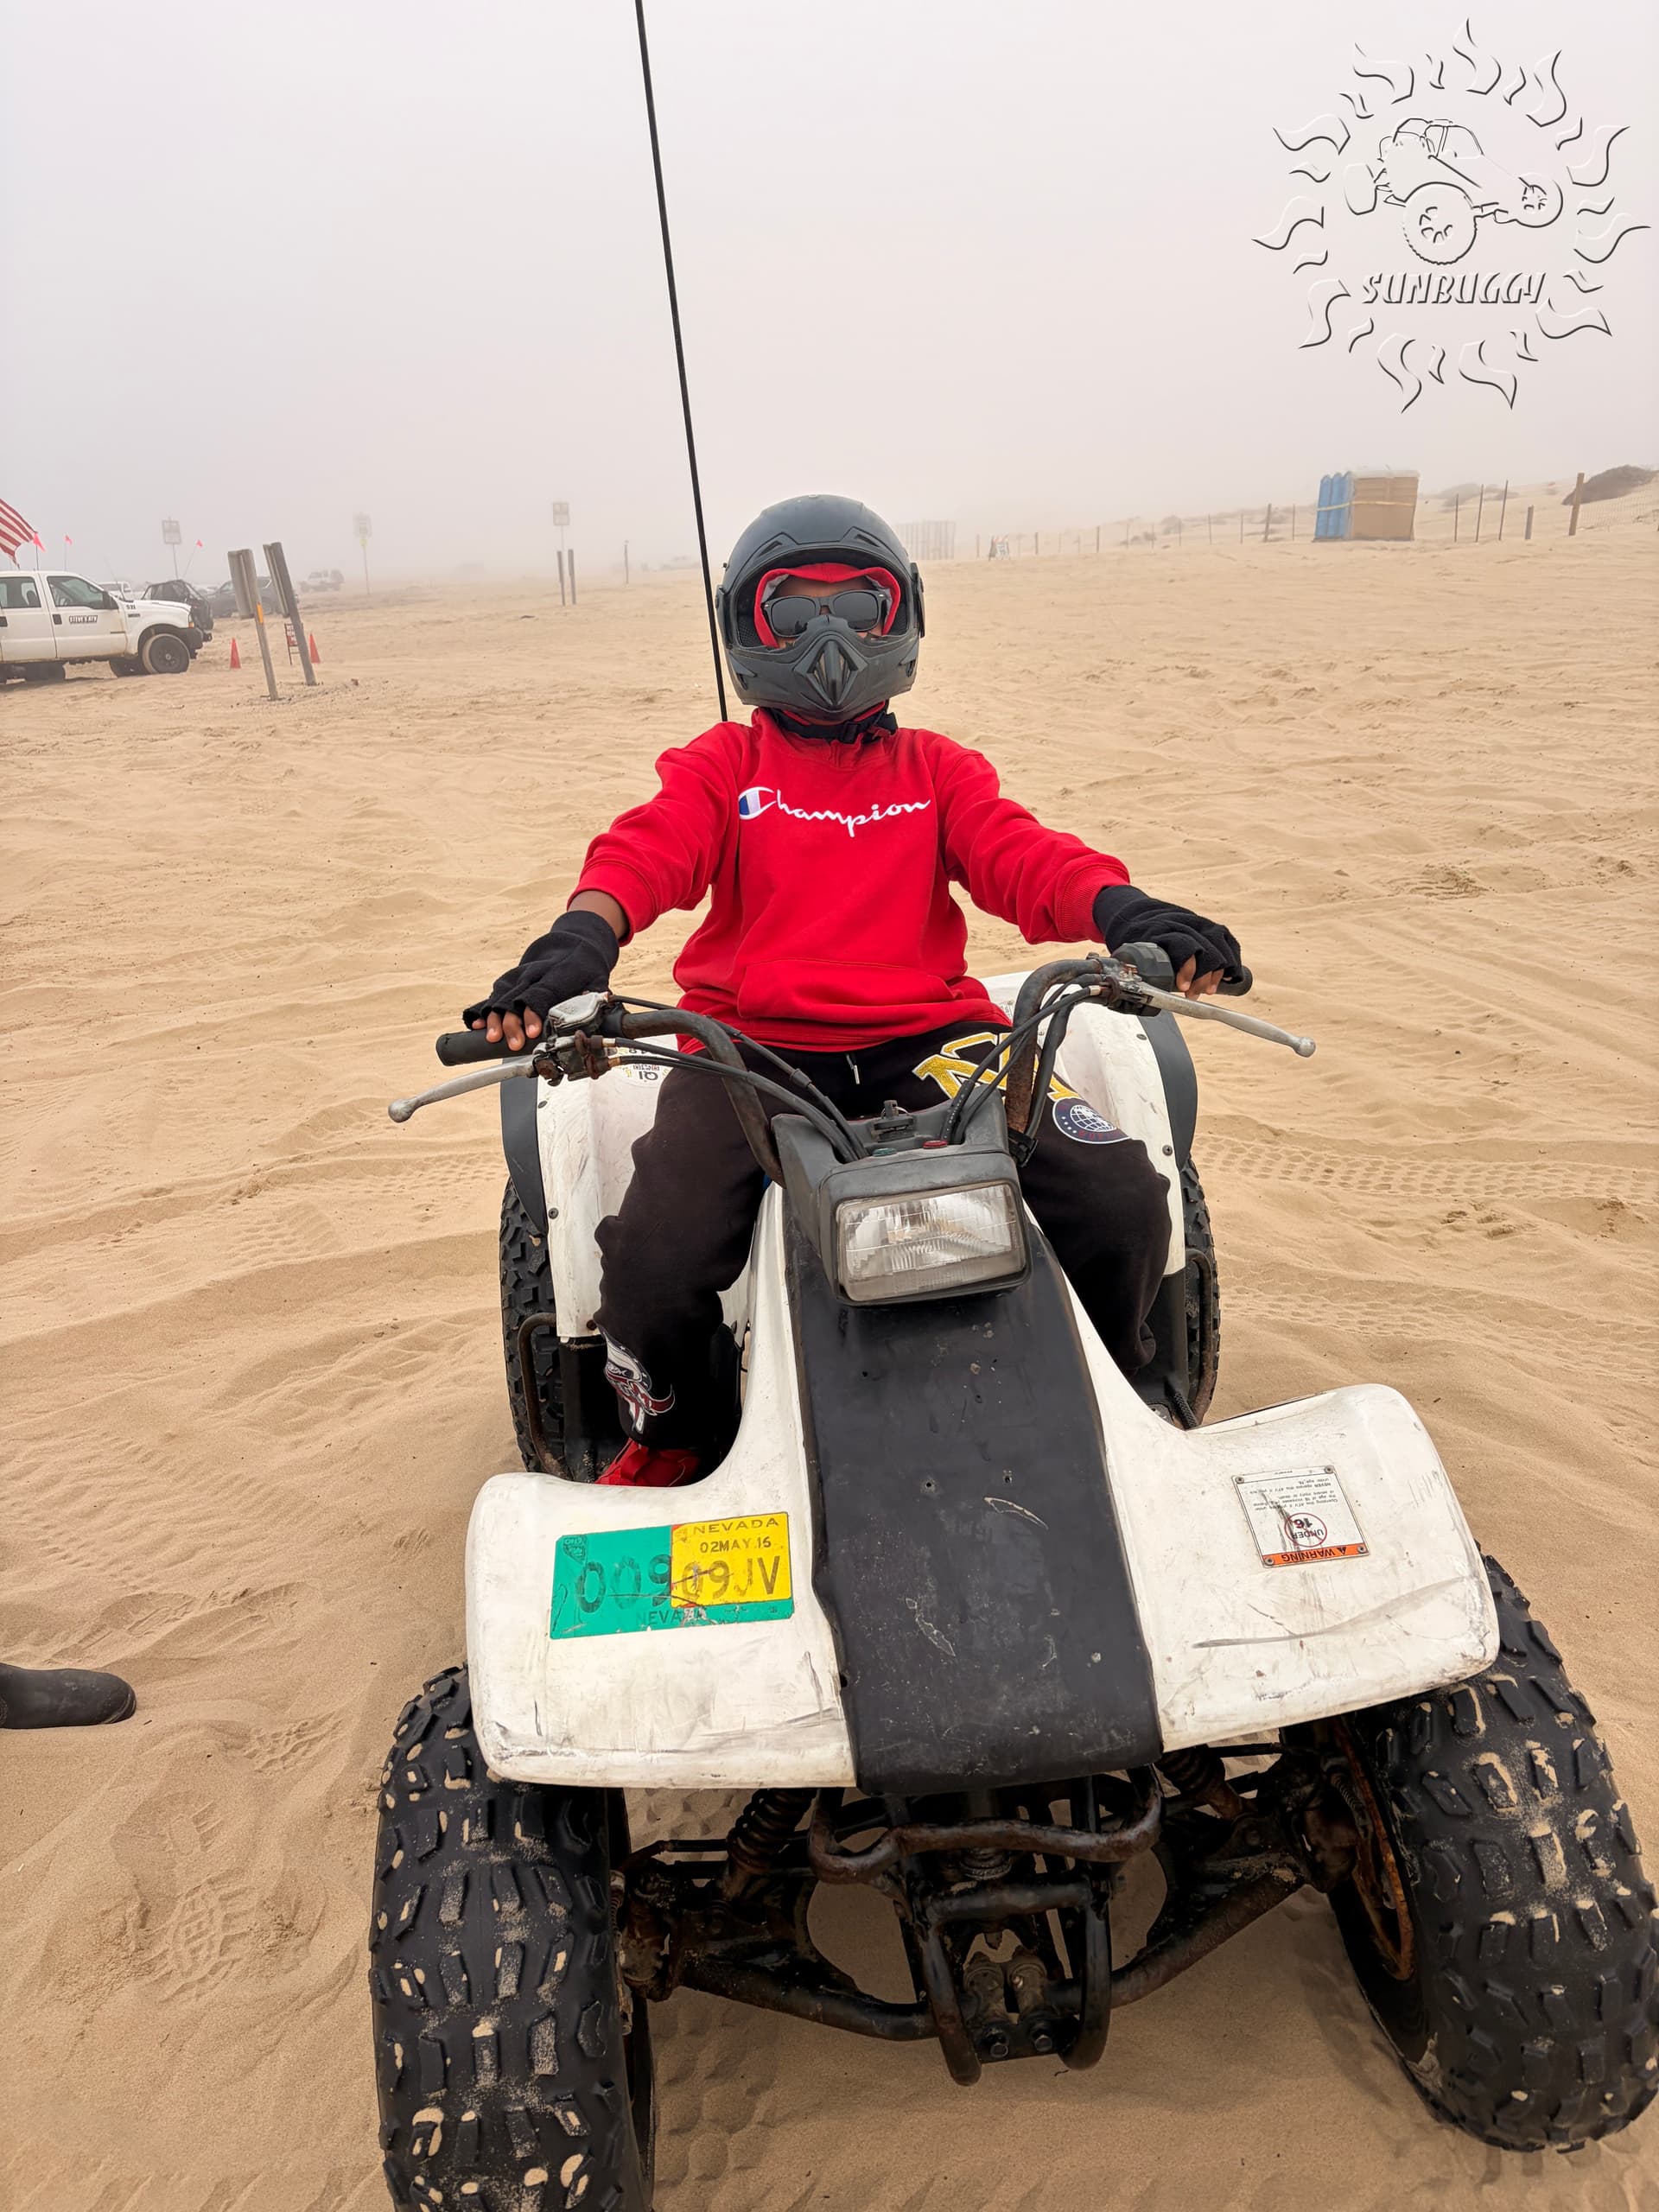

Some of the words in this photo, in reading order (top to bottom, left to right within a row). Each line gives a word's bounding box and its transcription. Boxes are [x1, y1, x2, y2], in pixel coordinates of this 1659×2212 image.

[738, 786, 931, 838] Champion
[693, 1517, 779, 1535] NEVADA
[1294, 1517, 1313, 1529] 16
[1291, 1529, 1325, 1540] UNDER
[1281, 1547, 1336, 1562] WARNING
